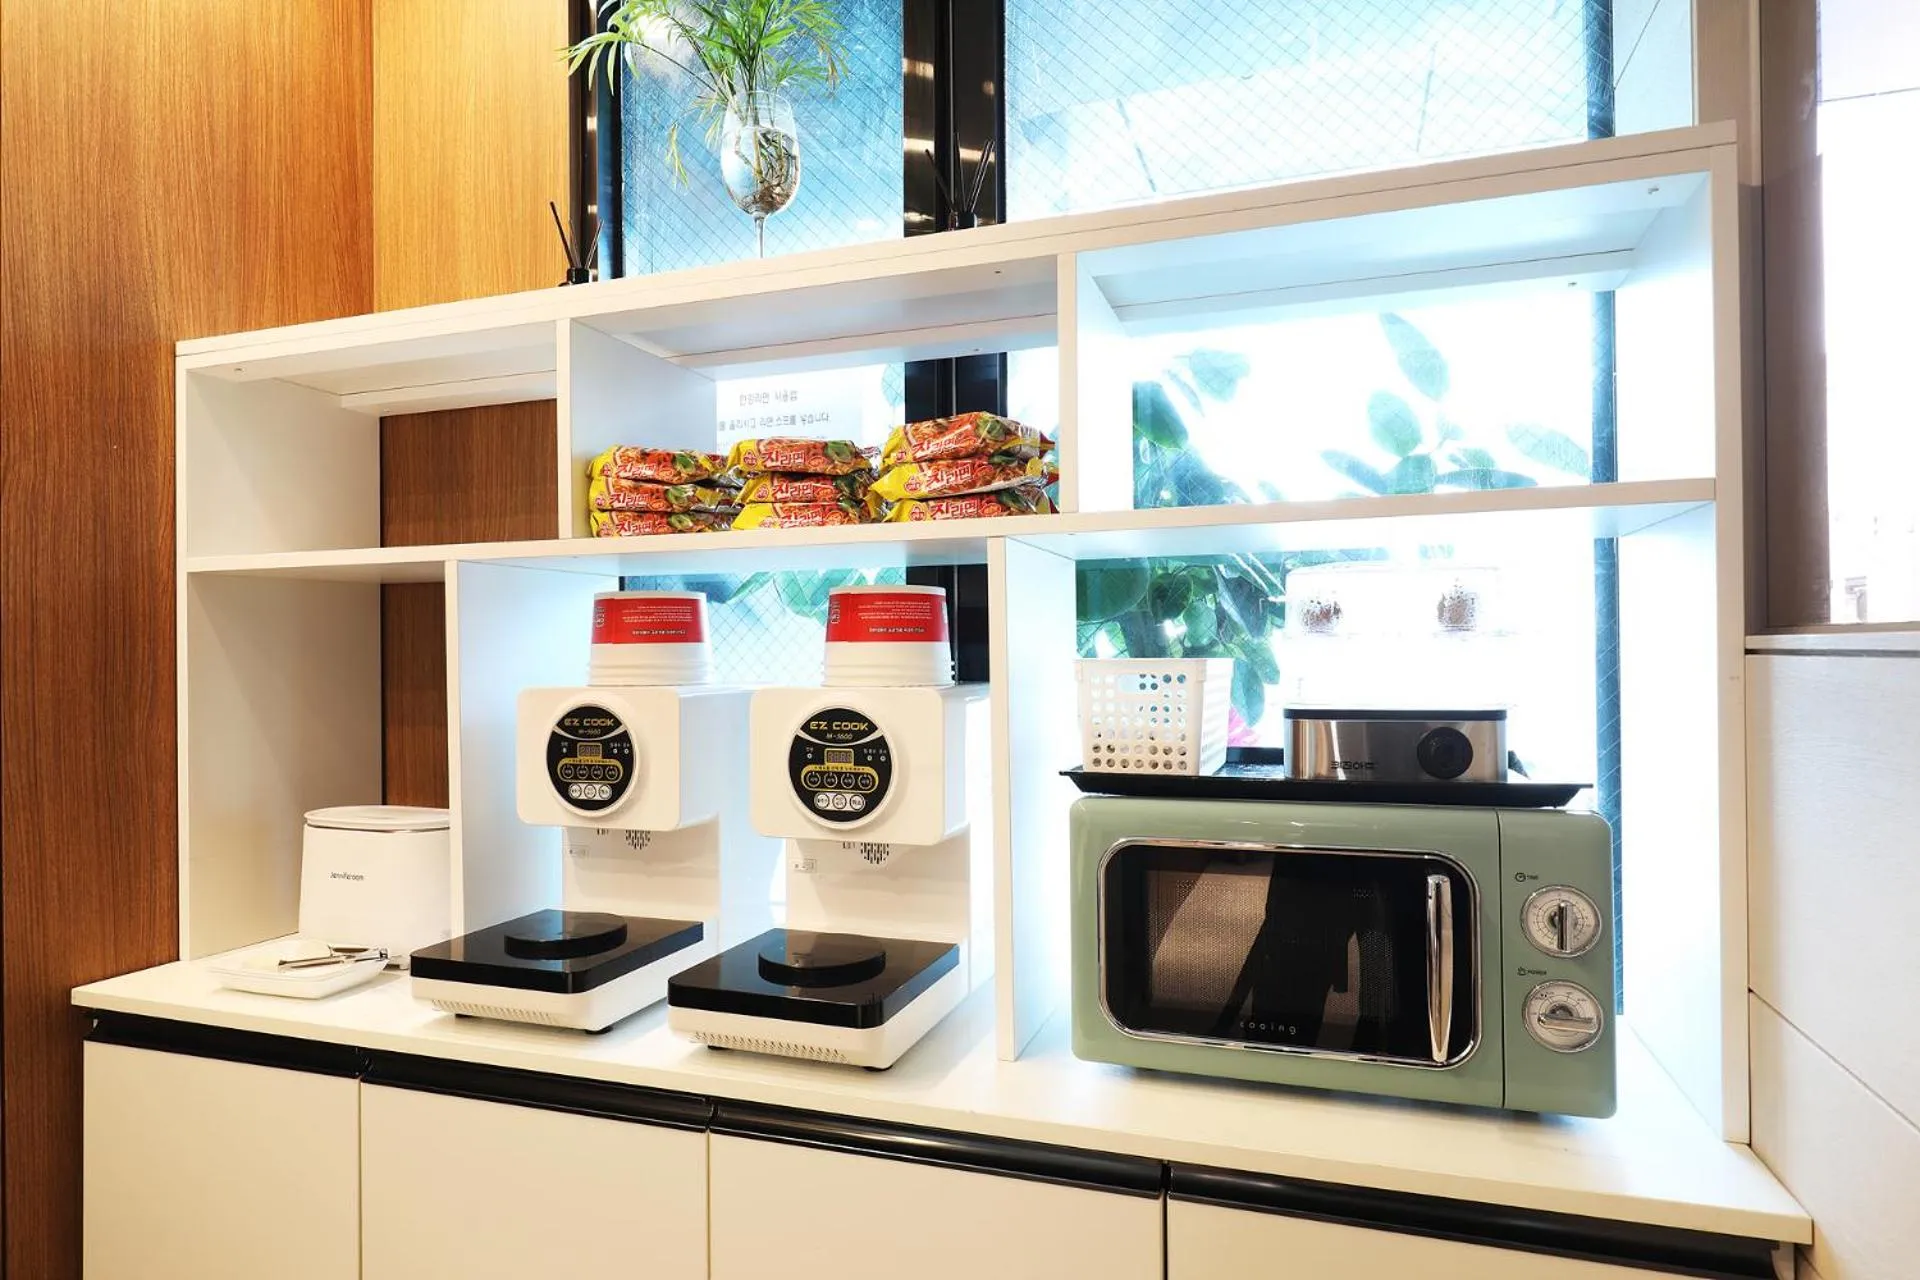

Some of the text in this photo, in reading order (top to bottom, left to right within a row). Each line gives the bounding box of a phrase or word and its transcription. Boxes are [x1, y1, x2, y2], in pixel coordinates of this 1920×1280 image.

[583, 718, 614, 727] COOK
[809, 721, 869, 731] EZ COOK
[1239, 1021, 1297, 1036] cooing
